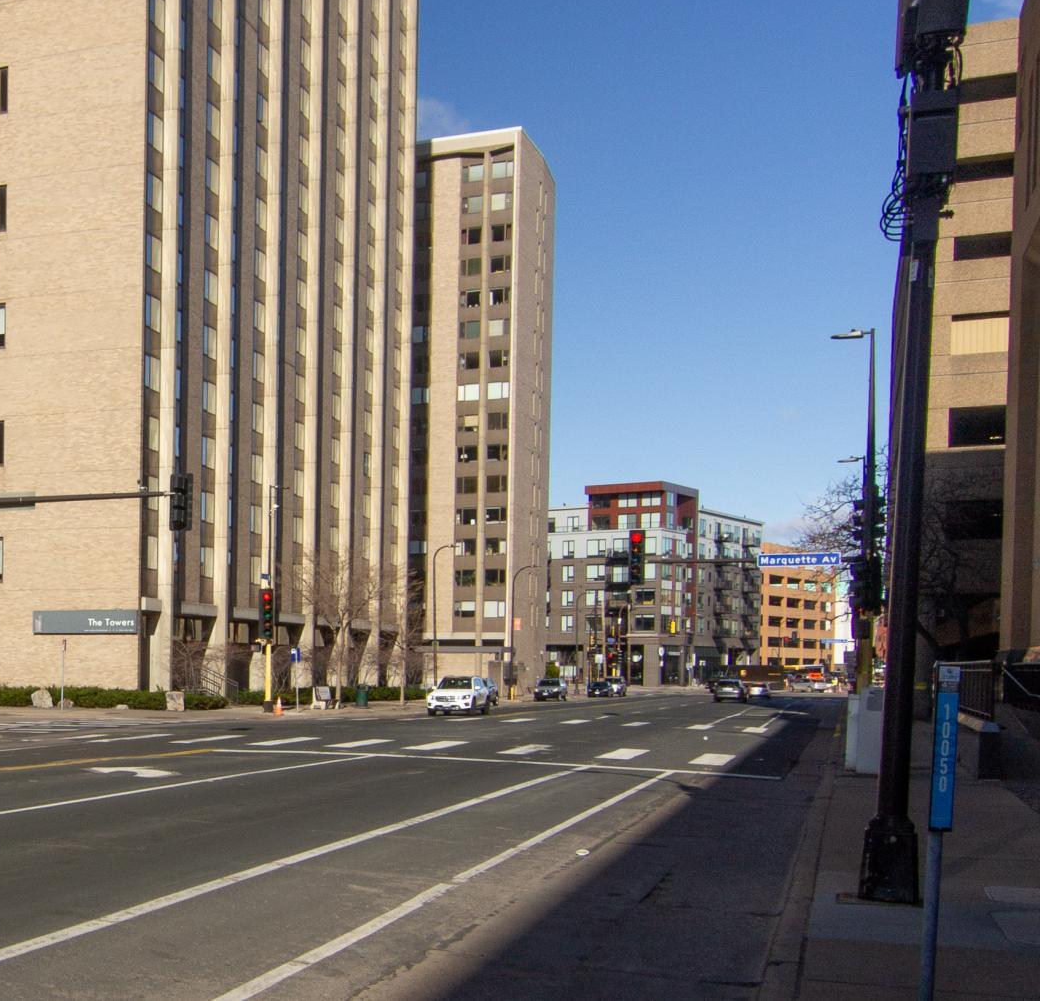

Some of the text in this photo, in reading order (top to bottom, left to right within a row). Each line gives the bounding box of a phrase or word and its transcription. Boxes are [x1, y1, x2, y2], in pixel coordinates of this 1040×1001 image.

[760, 556, 837, 566] Marquette Av
[87, 618, 134, 626] The Towers
[939, 703, 950, 792] 10050
